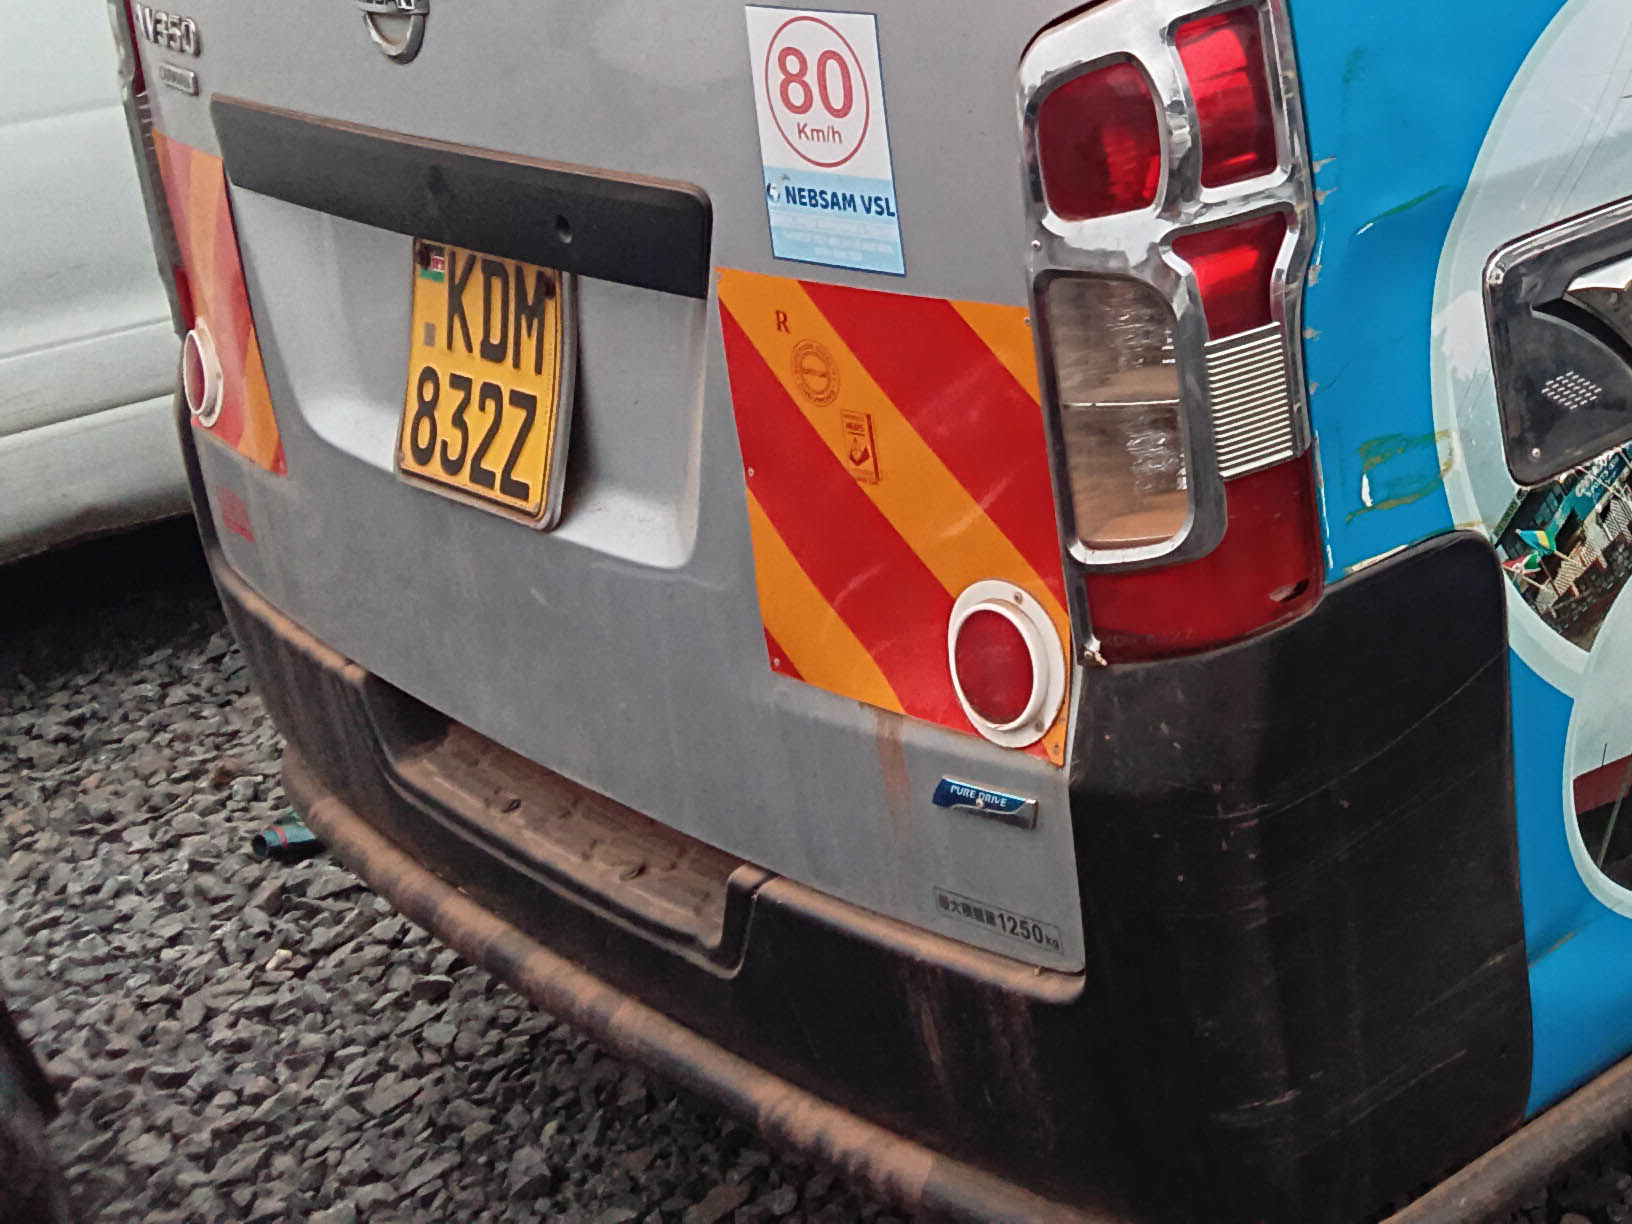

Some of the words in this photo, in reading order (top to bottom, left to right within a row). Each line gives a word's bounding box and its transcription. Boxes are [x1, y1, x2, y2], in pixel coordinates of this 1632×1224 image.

[777, 46, 853, 118] 80
[797, 122, 842, 144] Km/h
[785, 186, 856, 213] NEBSAM
[860, 195, 895, 217] VSL
[447, 251, 546, 375] KDM
[776, 310, 790, 334] R
[410, 366, 537, 502] 832Z
[950, 784, 976, 798] PURE
[979, 792, 1007, 807] DRIVE
